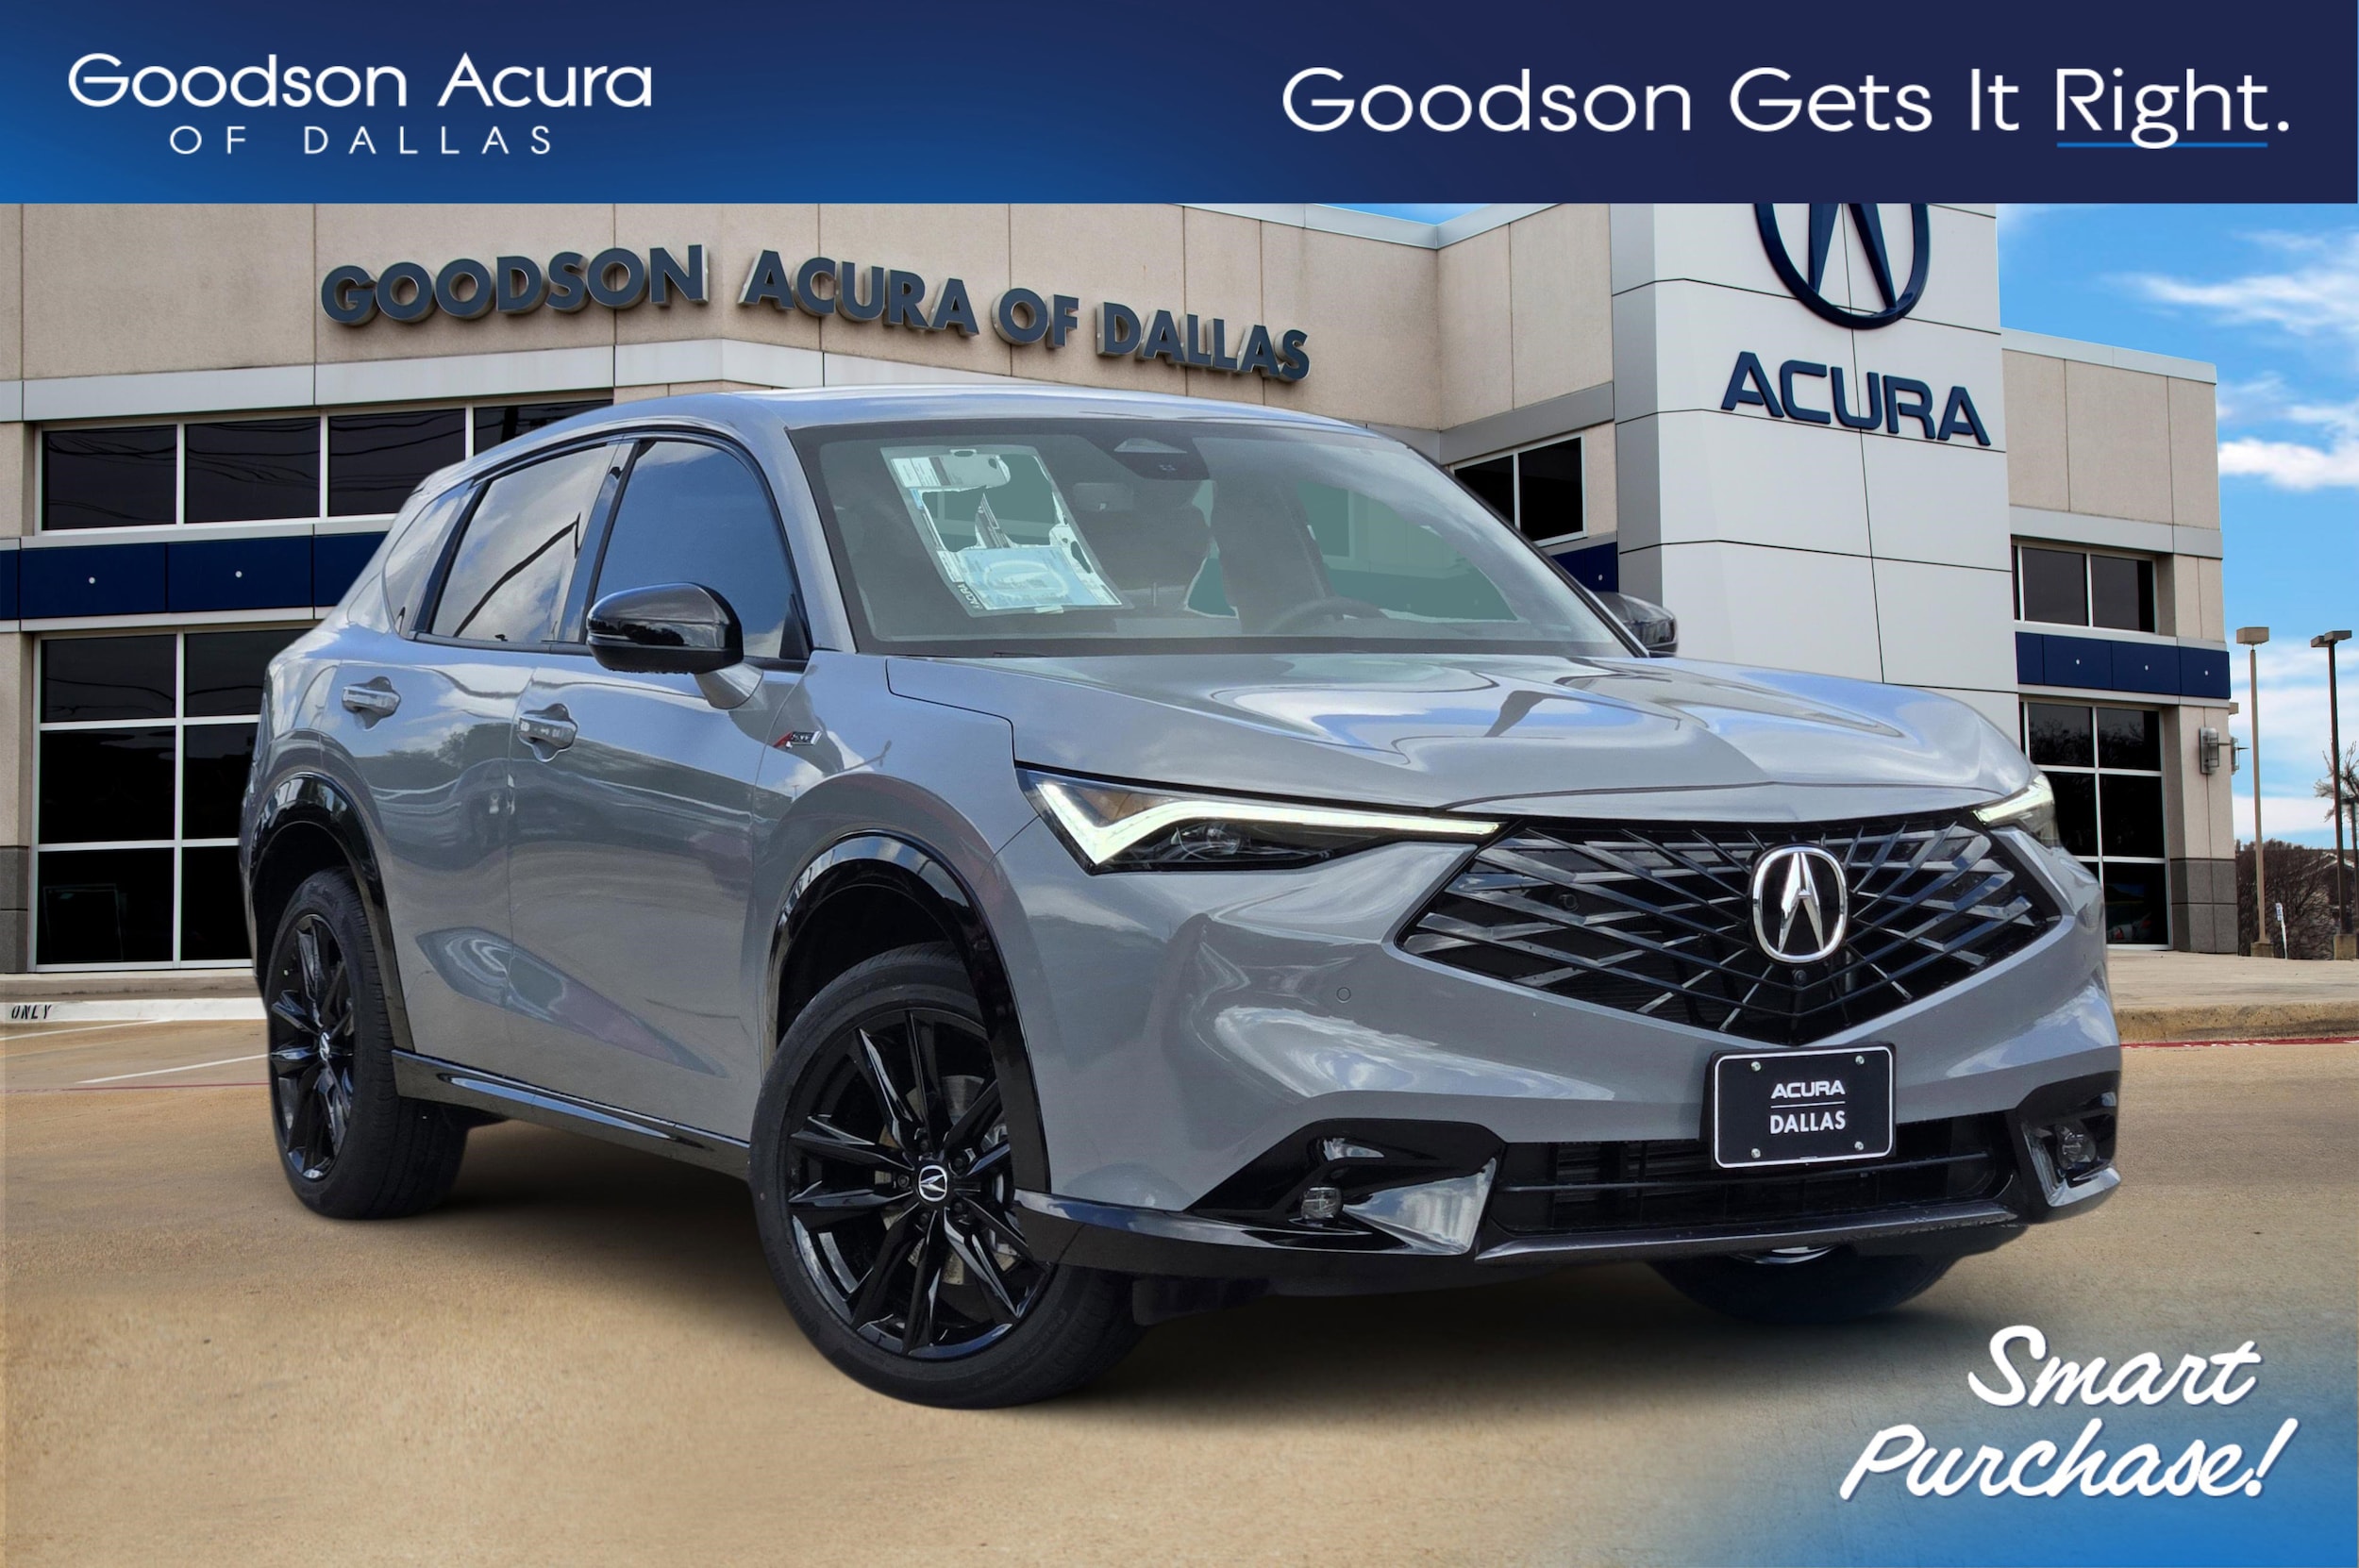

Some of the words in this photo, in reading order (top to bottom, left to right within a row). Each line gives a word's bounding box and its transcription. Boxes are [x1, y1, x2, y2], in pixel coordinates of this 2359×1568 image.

[321, 244, 709, 326] GOODSON
[738, 249, 979, 337] ACURA
[992, 288, 1079, 349] OF
[1096, 301, 1311, 383] DALLAS
[1721, 351, 1991, 447] ACURA
[11, 1004, 52, 1020] ONLY
[1770, 1079, 1846, 1099] ACURA
[1769, 1109, 1847, 1135] DALLAS
